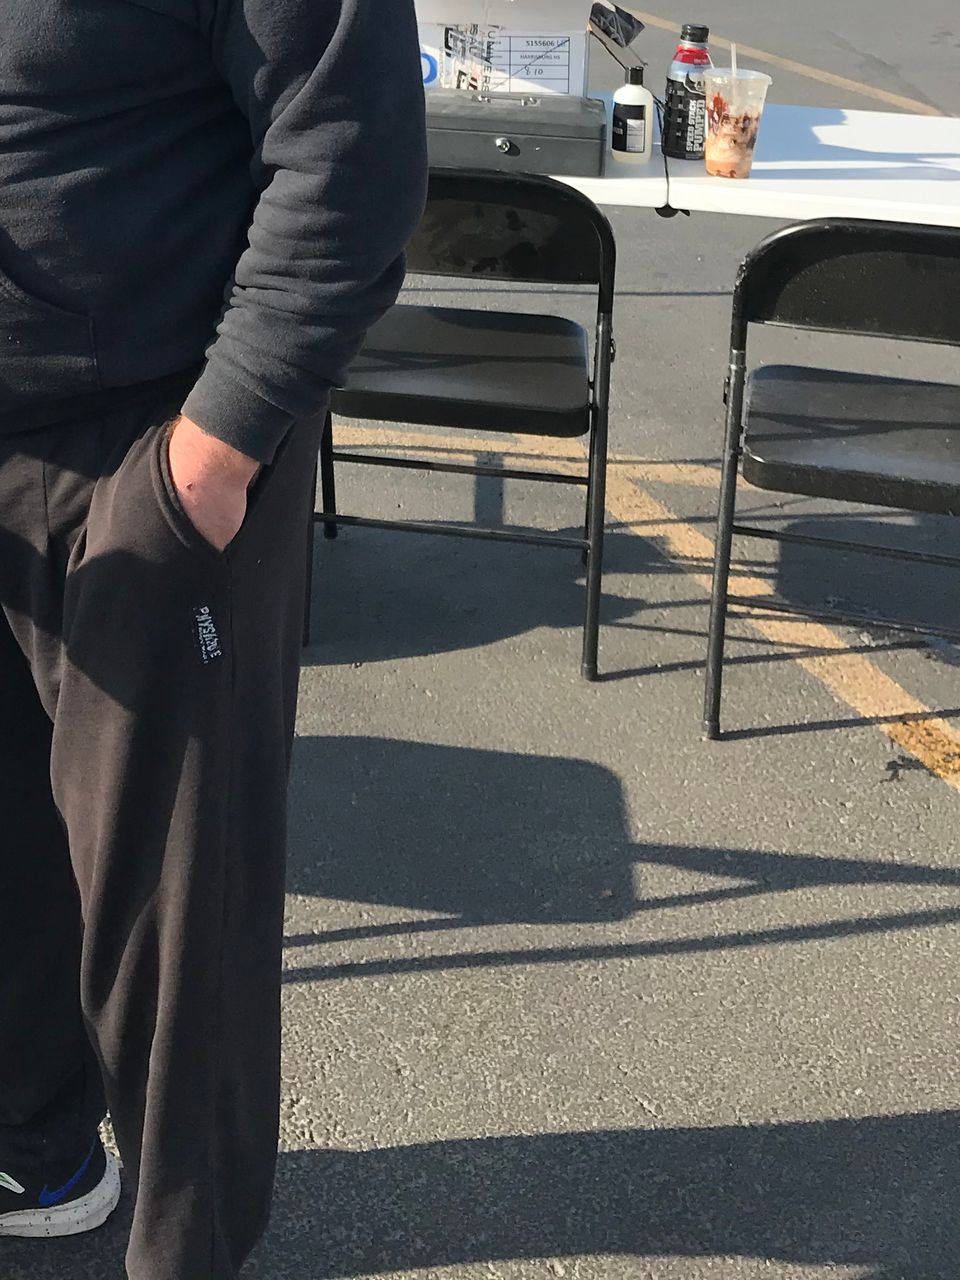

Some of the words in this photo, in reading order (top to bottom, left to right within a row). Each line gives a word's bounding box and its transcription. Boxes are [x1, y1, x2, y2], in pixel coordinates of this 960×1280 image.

[688, 99, 697, 125] STACK
[693, 99, 706, 152] PUMPED
[685, 126, 694, 152] SPEED
